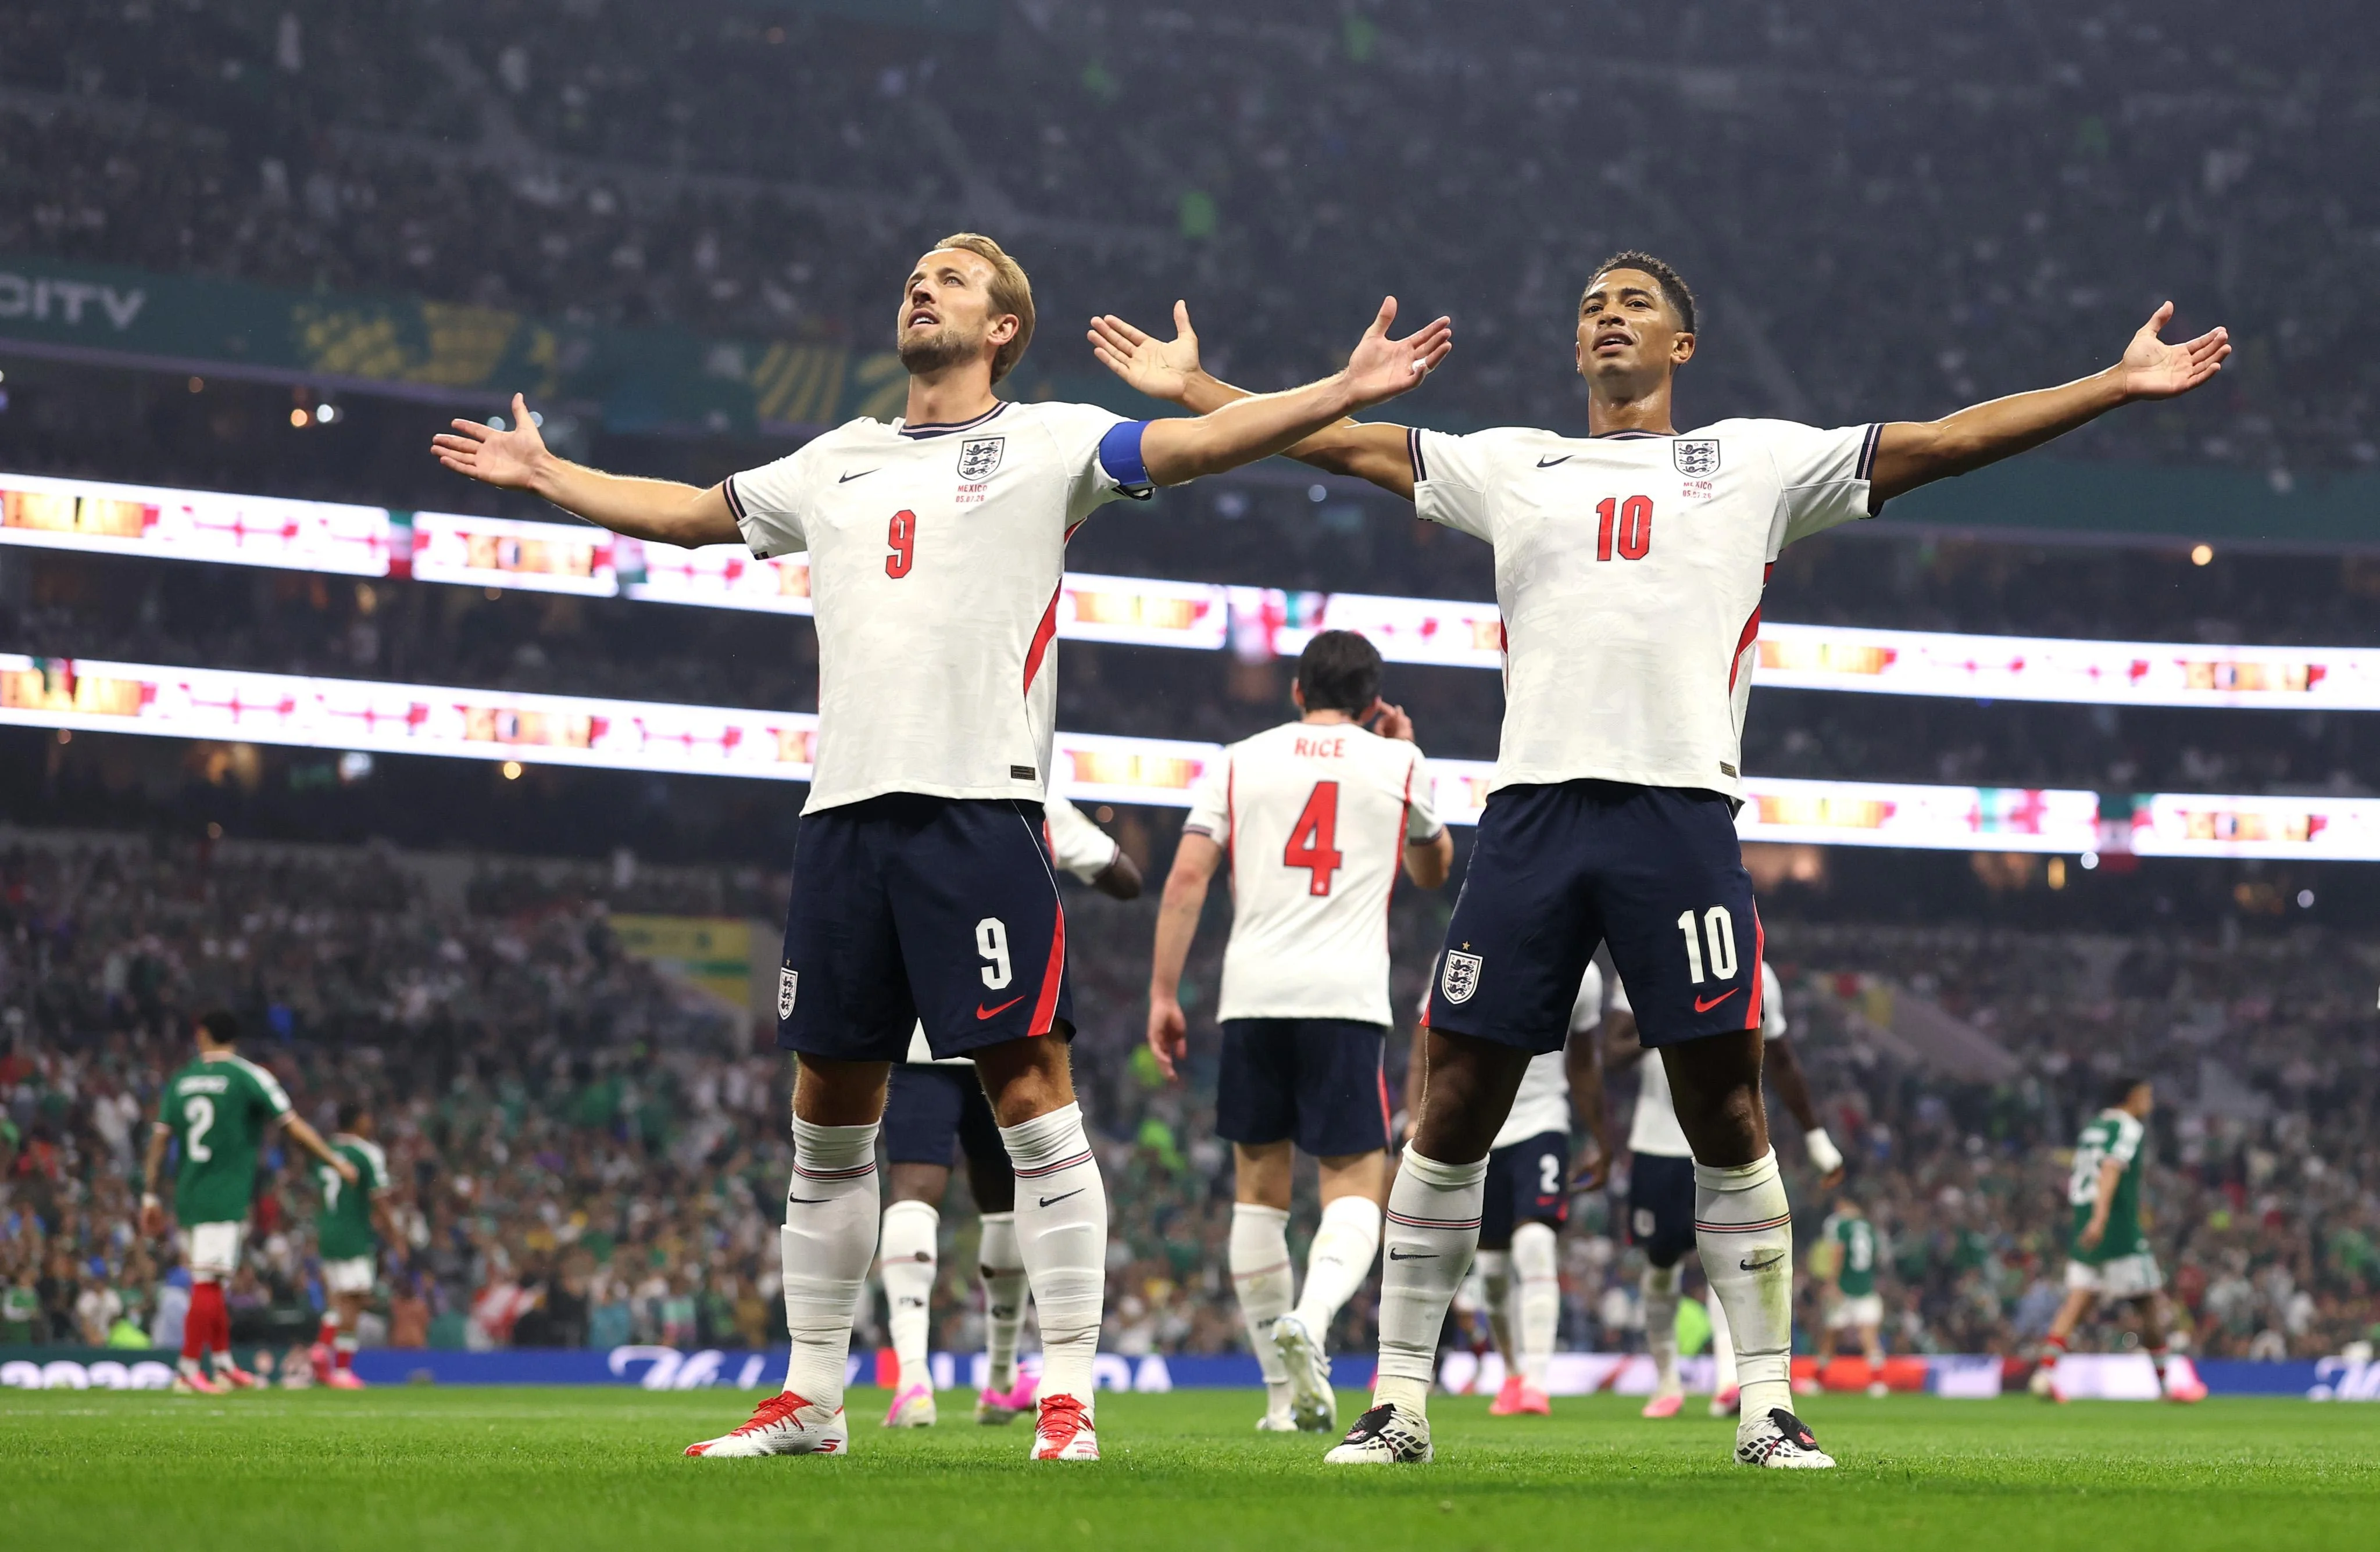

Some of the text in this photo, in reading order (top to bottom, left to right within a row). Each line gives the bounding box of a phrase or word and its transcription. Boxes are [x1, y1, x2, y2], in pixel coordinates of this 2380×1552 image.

[956, 495, 985, 503] 05.07.26
[957, 484, 988, 492] MEXICO
[1684, 481, 1712, 490] MEXICO
[885, 509, 916, 579] 9
[1596, 495, 1653, 562] 10
[1295, 738, 1345, 758] RICE
[1284, 781, 1342, 896] 4
[975, 917, 1013, 990] 9
[1677, 904, 1738, 984] 10
[184, 1095, 214, 1162] 2
[1539, 1153, 1560, 1194] 2
